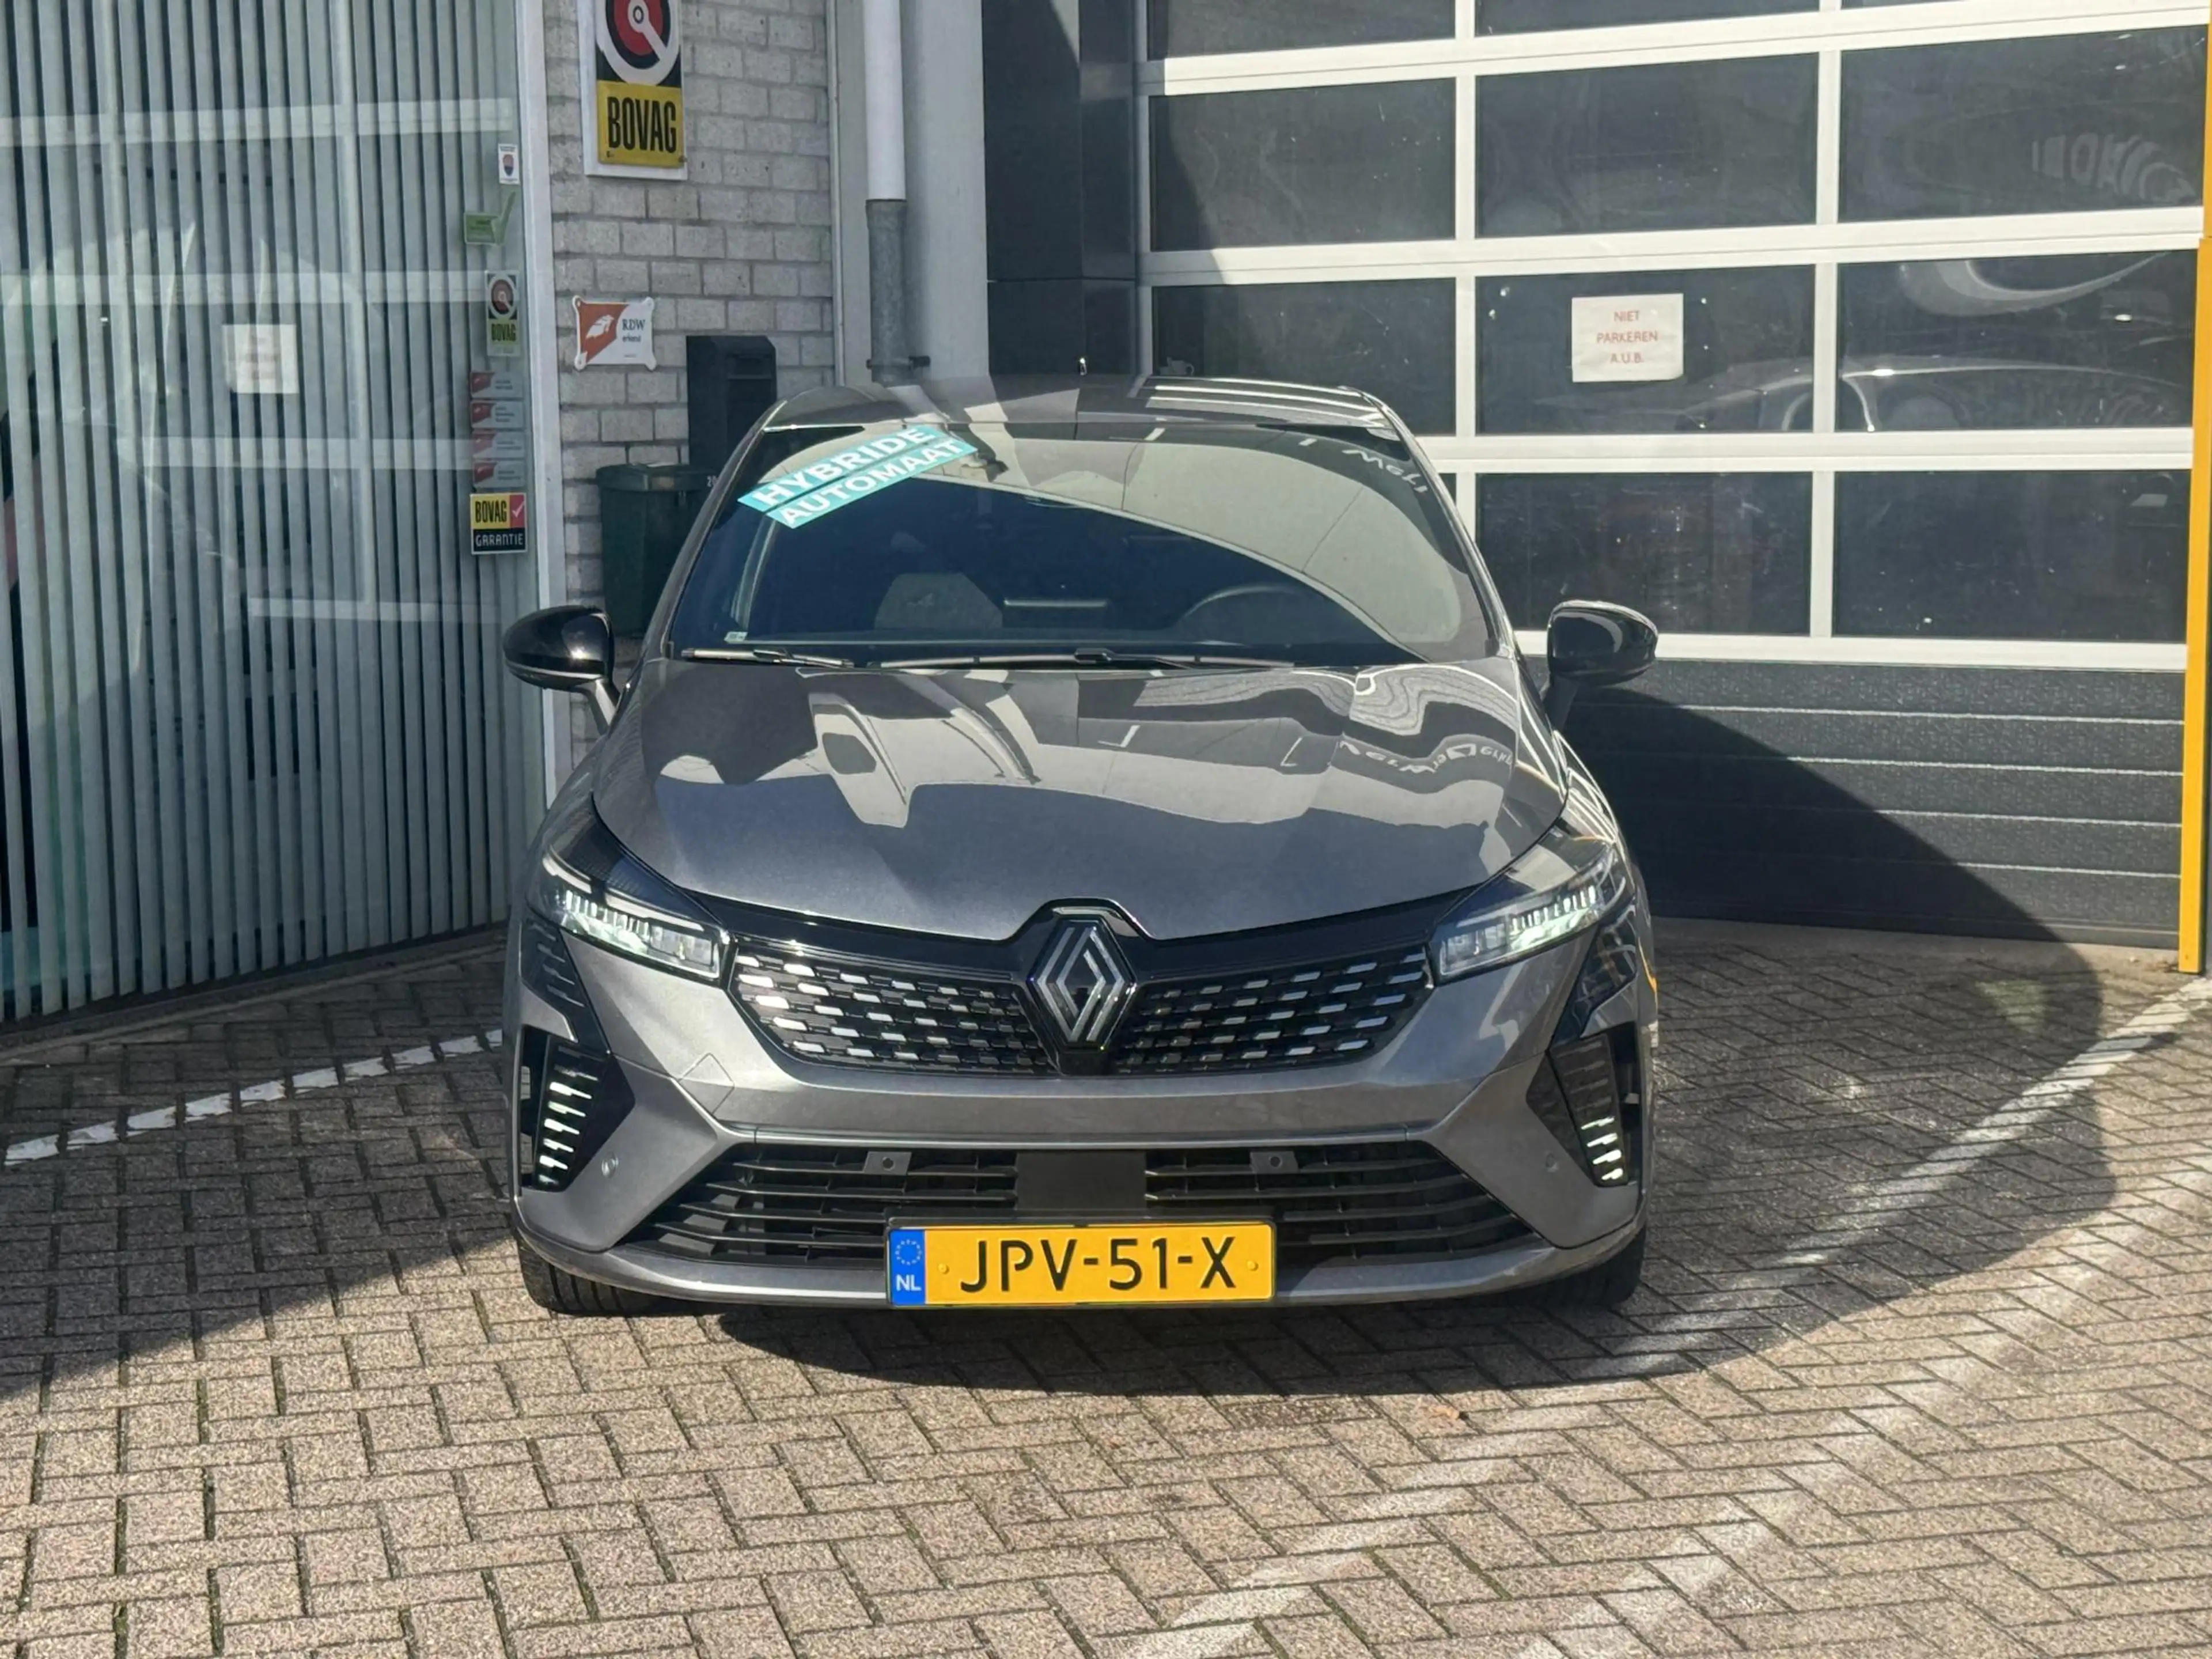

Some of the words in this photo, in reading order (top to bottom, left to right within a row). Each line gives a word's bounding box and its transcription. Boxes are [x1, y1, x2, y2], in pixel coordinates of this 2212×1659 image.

[607, 96, 677, 153] BOVAG
[622, 319, 646, 331] RDW
[1613, 310, 1640, 323] NIET
[491, 323, 517, 341] BOVAG
[1596, 330, 1658, 344] PARKEREN
[752, 427, 935, 507] HYBRIDE
[779, 440, 964, 524] AUTOMAAT
[475, 500, 507, 523] BOVAG
[475, 533, 524, 547] GARANTIE
[960, 1236, 1237, 1292] JPV-51-X
[896, 1274, 921, 1292] NL
